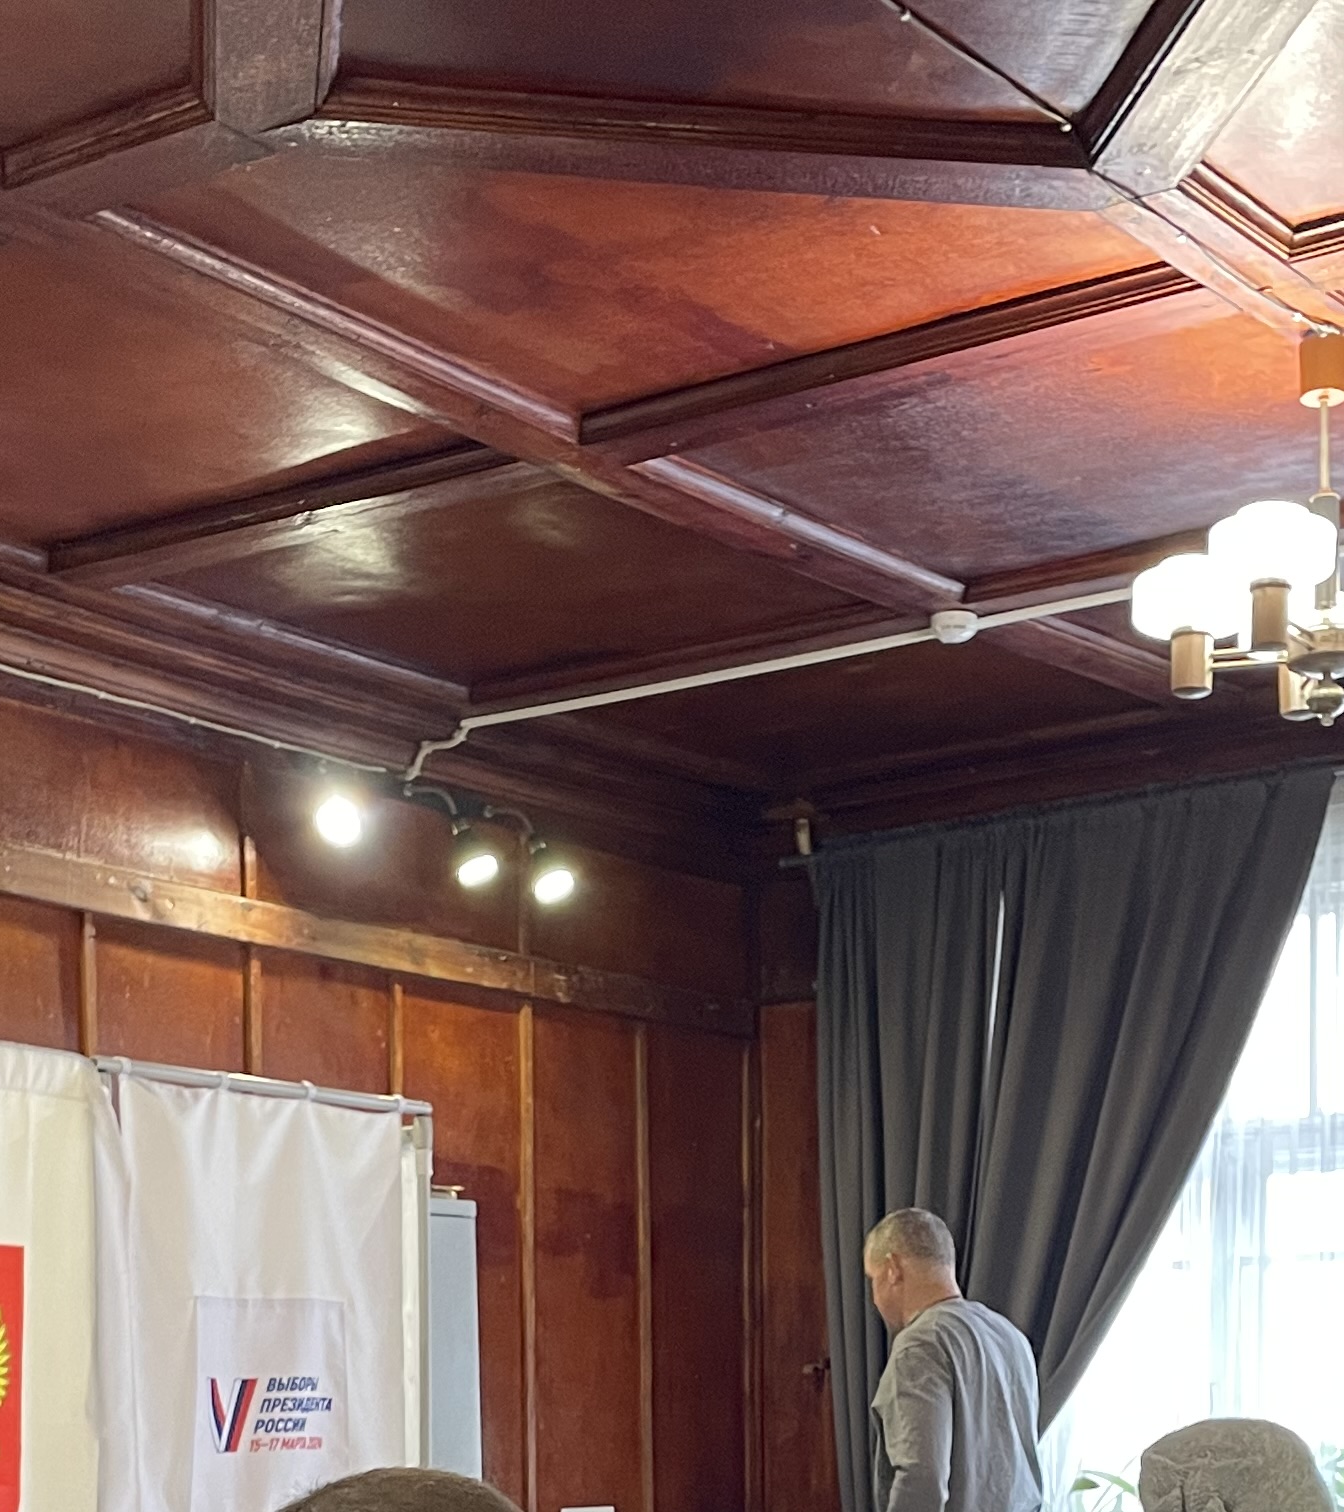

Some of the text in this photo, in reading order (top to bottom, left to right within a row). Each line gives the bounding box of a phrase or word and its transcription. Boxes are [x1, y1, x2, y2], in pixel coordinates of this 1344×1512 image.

[266, 1376, 319, 1392] ВЫБОРЫ
[259, 1397, 332, 1413] ПРЕЗИДЕНТА
[253, 1418, 307, 1434] РОССИИ
